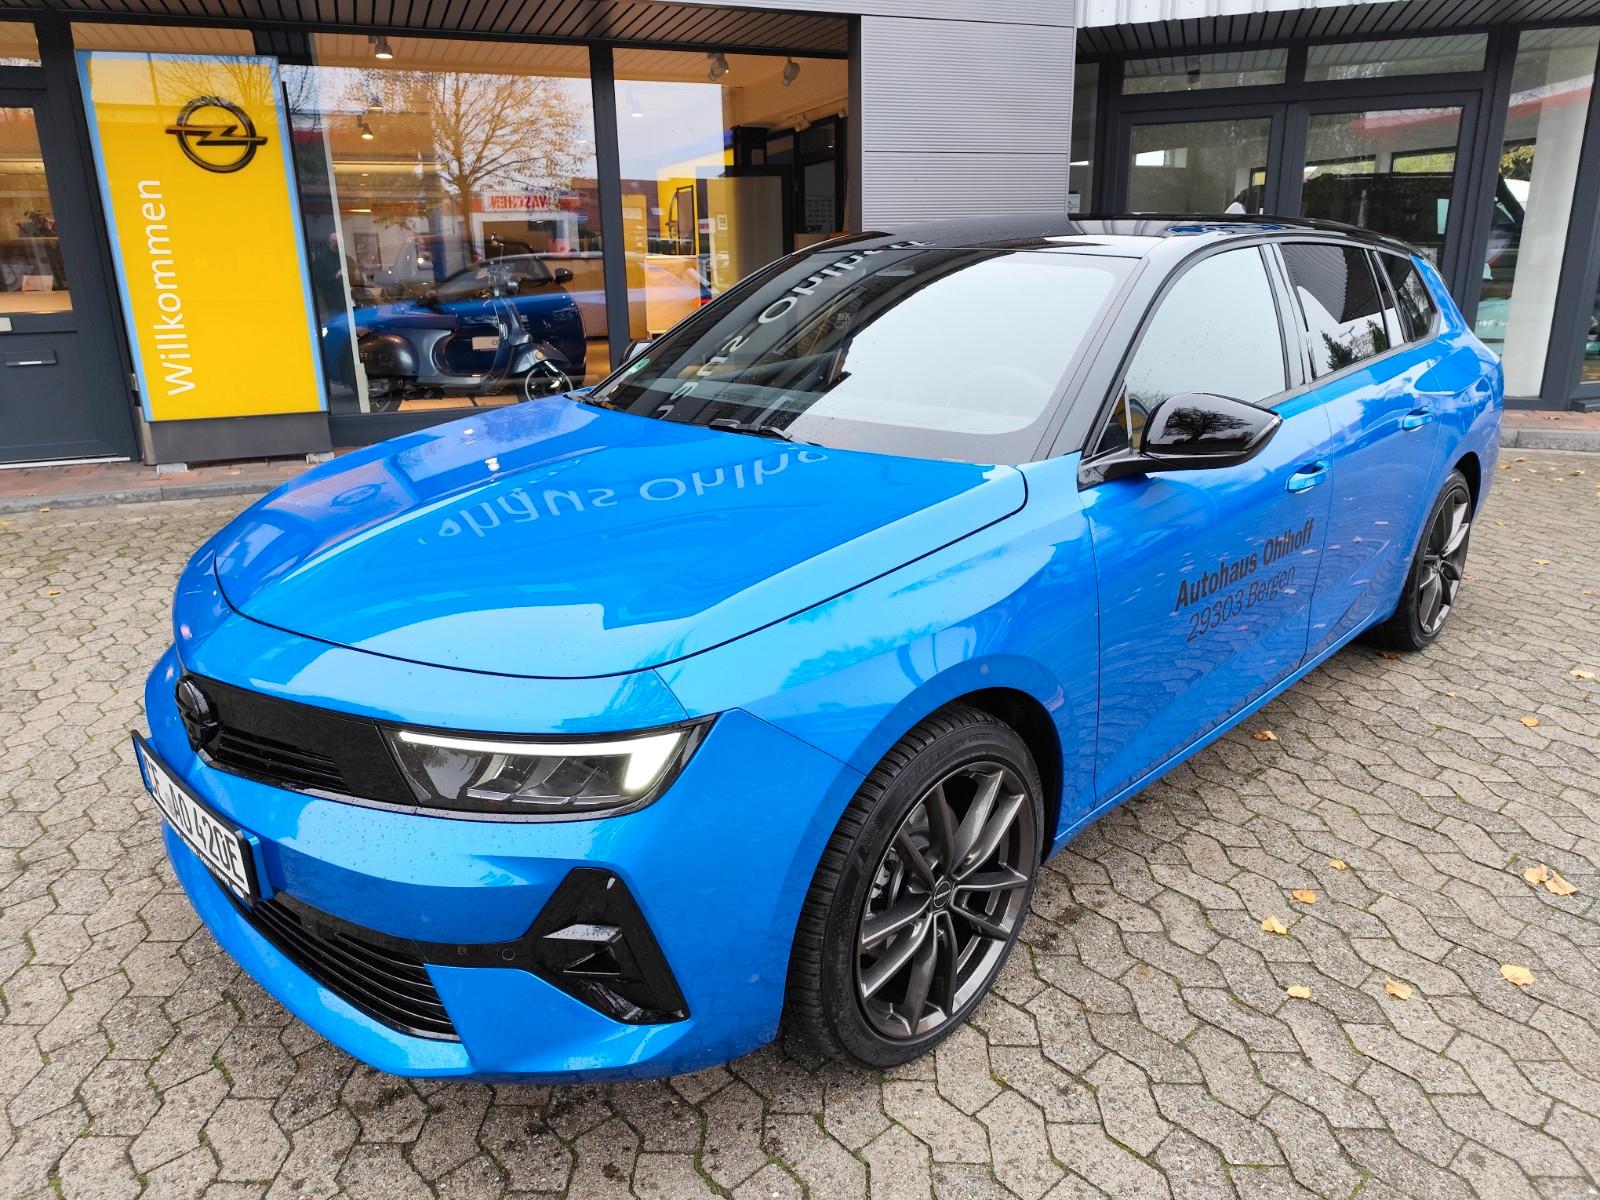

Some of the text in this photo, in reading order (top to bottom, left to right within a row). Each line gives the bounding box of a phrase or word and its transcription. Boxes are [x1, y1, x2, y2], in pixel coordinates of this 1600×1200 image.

[137, 179, 196, 396] Willkommen
[1174, 518, 1315, 612] Autohaus Ohlhoff
[1186, 566, 1296, 643] 29303 Bergen
[194, 807, 245, 883] 420E
